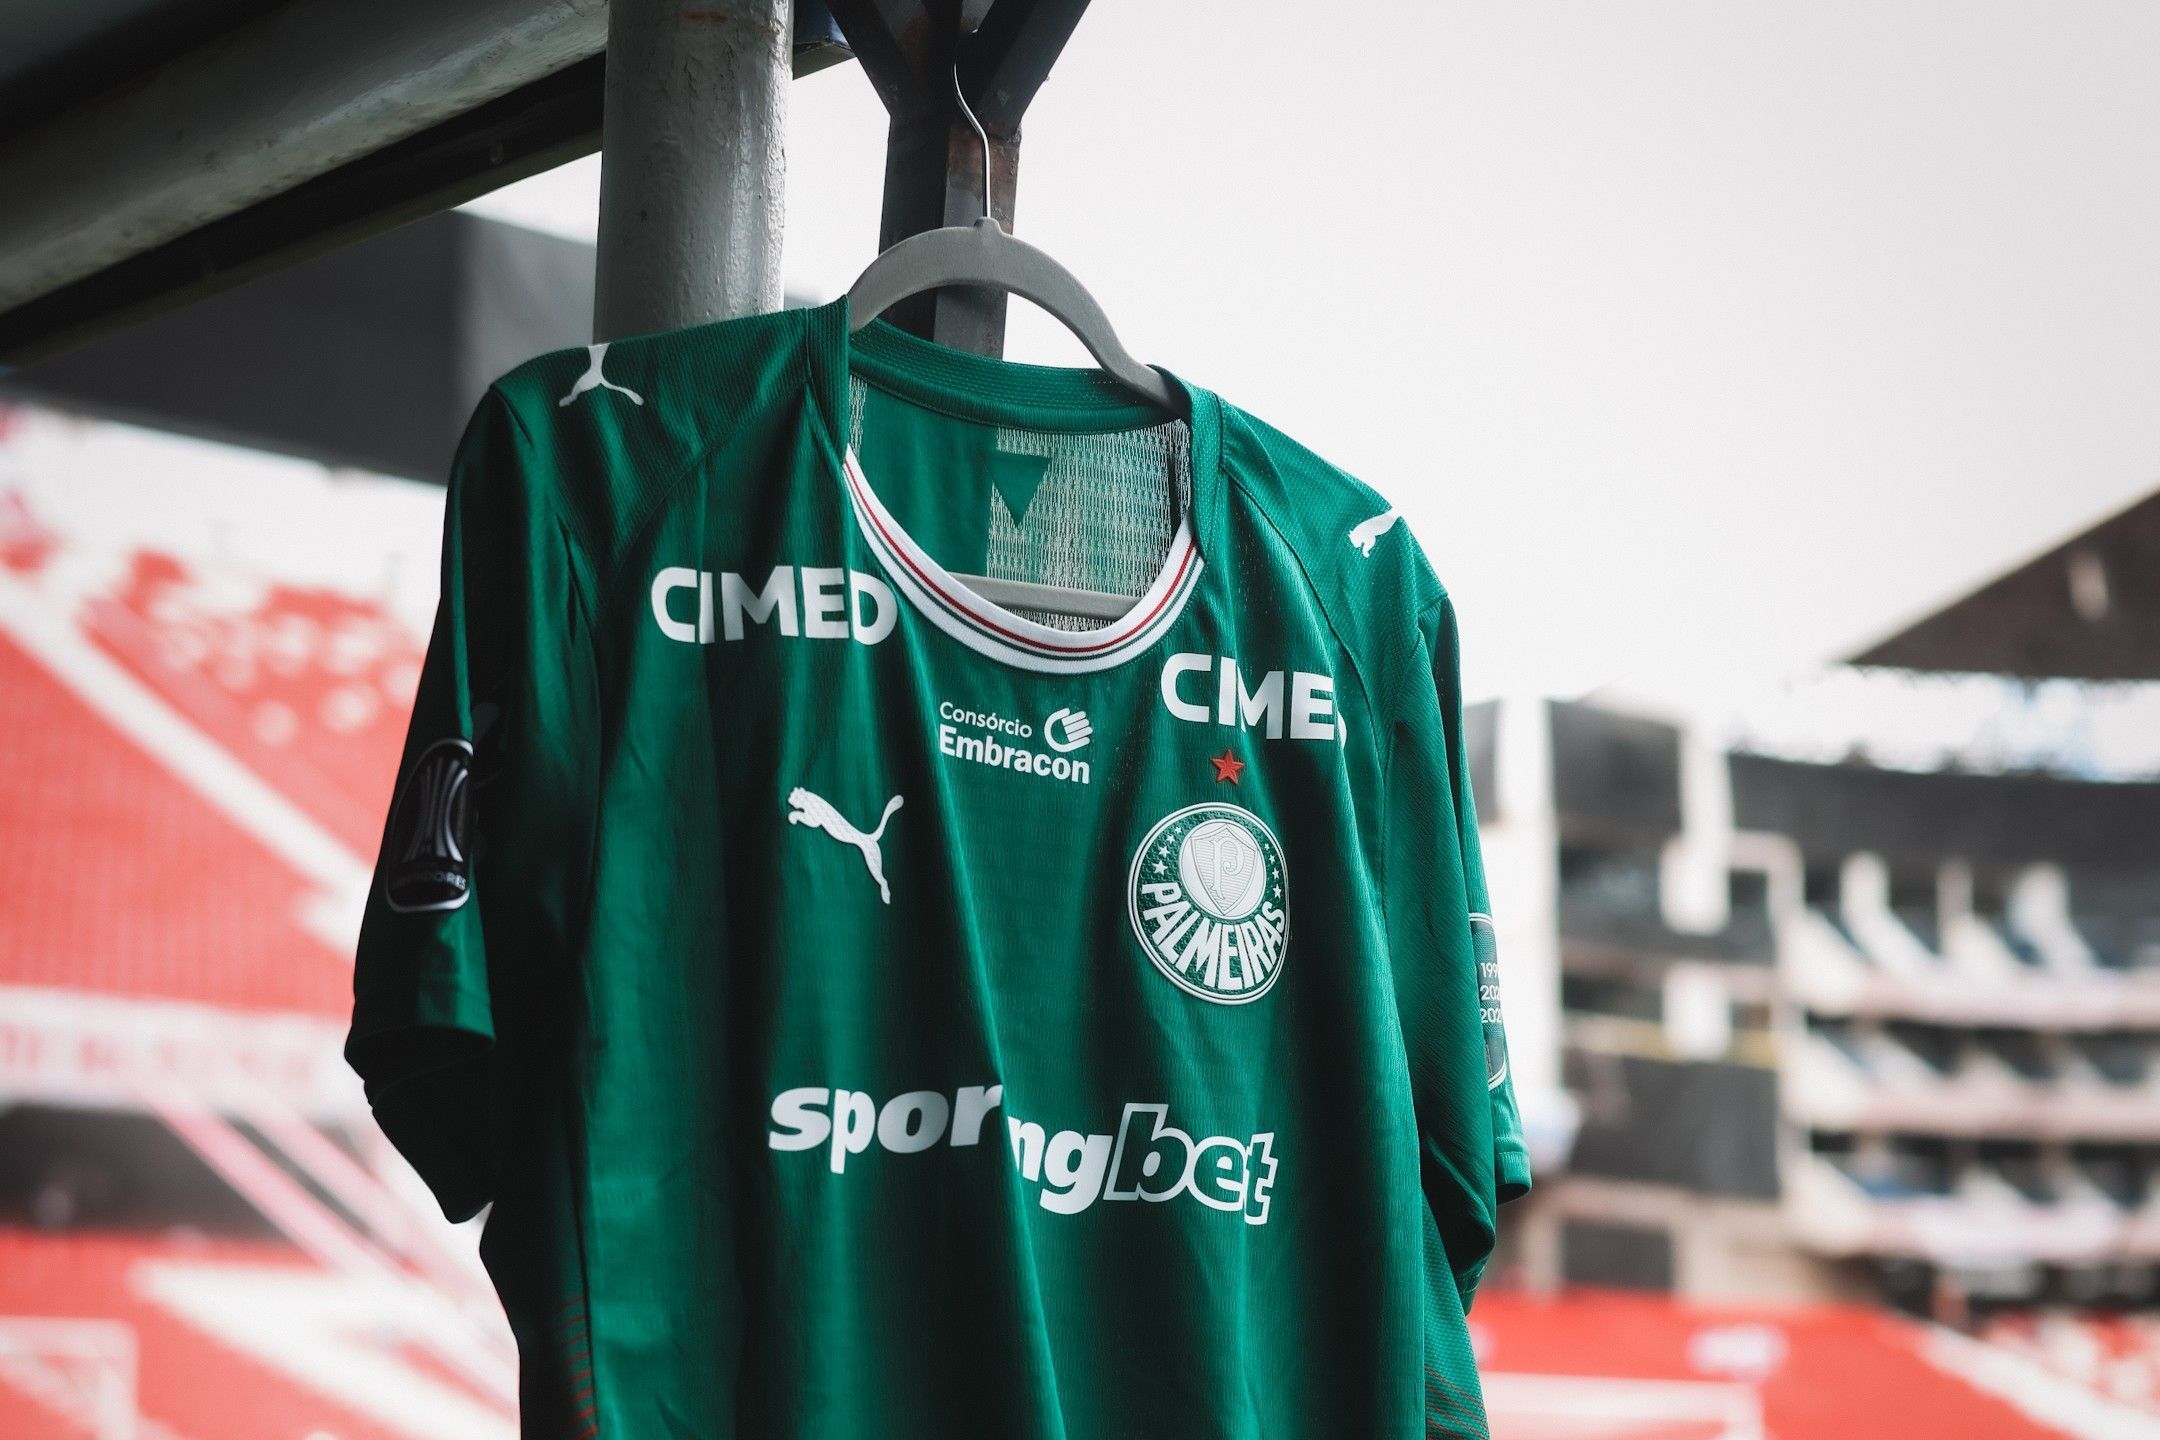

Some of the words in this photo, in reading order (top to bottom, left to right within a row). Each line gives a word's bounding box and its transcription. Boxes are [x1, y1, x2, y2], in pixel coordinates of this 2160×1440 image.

[651, 565, 898, 646] CIMED
[939, 701, 1033, 738] Consórcio
[1161, 652, 1348, 750] CIME
[939, 723, 1091, 785] Embracon
[1141, 881, 1287, 990] PALMEIRAS
[1479, 984, 1501, 1001] 202
[1480, 962, 1499, 978] 199
[1479, 1007, 1503, 1024] 202
[768, 1084, 1279, 1225] sporngbet
